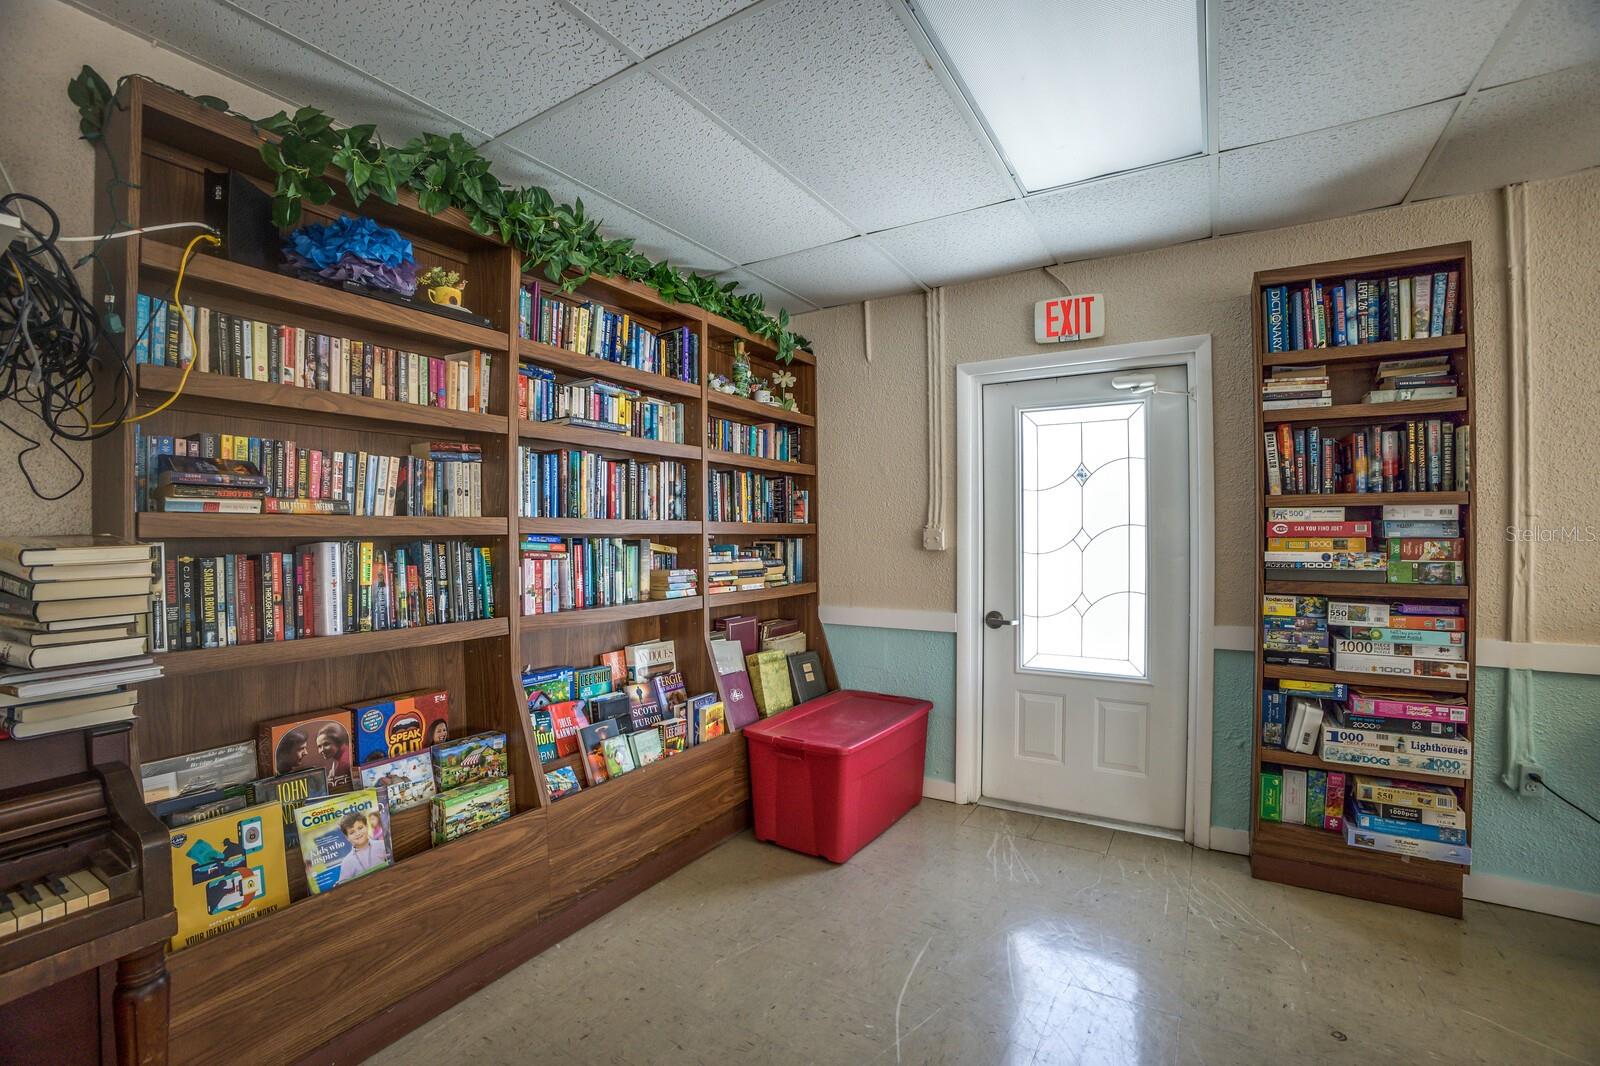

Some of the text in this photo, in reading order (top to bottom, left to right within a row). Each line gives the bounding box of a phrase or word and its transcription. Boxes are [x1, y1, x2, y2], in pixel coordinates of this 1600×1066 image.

[1046, 296, 1095, 338] EXIT
[1271, 291, 1282, 350] DICTIONARY
[1288, 510, 1304, 518] 500
[203, 568, 216, 623] SANDRA BROWN
[1330, 609, 1347, 618] 550
[1339, 641, 1373, 654] 1000
[580, 674, 594, 687] LEE
[632, 704, 659, 718] SCOTT
[632, 714, 662, 729] TUROW
[390, 728, 422, 744] SPEAK
[1325, 730, 1365, 744] 1000
[1410, 741, 1468, 756] Lighthouses
[1363, 756, 1391, 767] DOGS
[278, 778, 309, 804] JOHN
[1376, 791, 1393, 800] 550
[301, 800, 373, 828] Connection
[329, 841, 346, 852] who
[311, 851, 340, 865] inspire
[185, 931, 205, 946] YOUR
[238, 911, 256, 926] YOUR
[256, 903, 278, 919] MONEY
